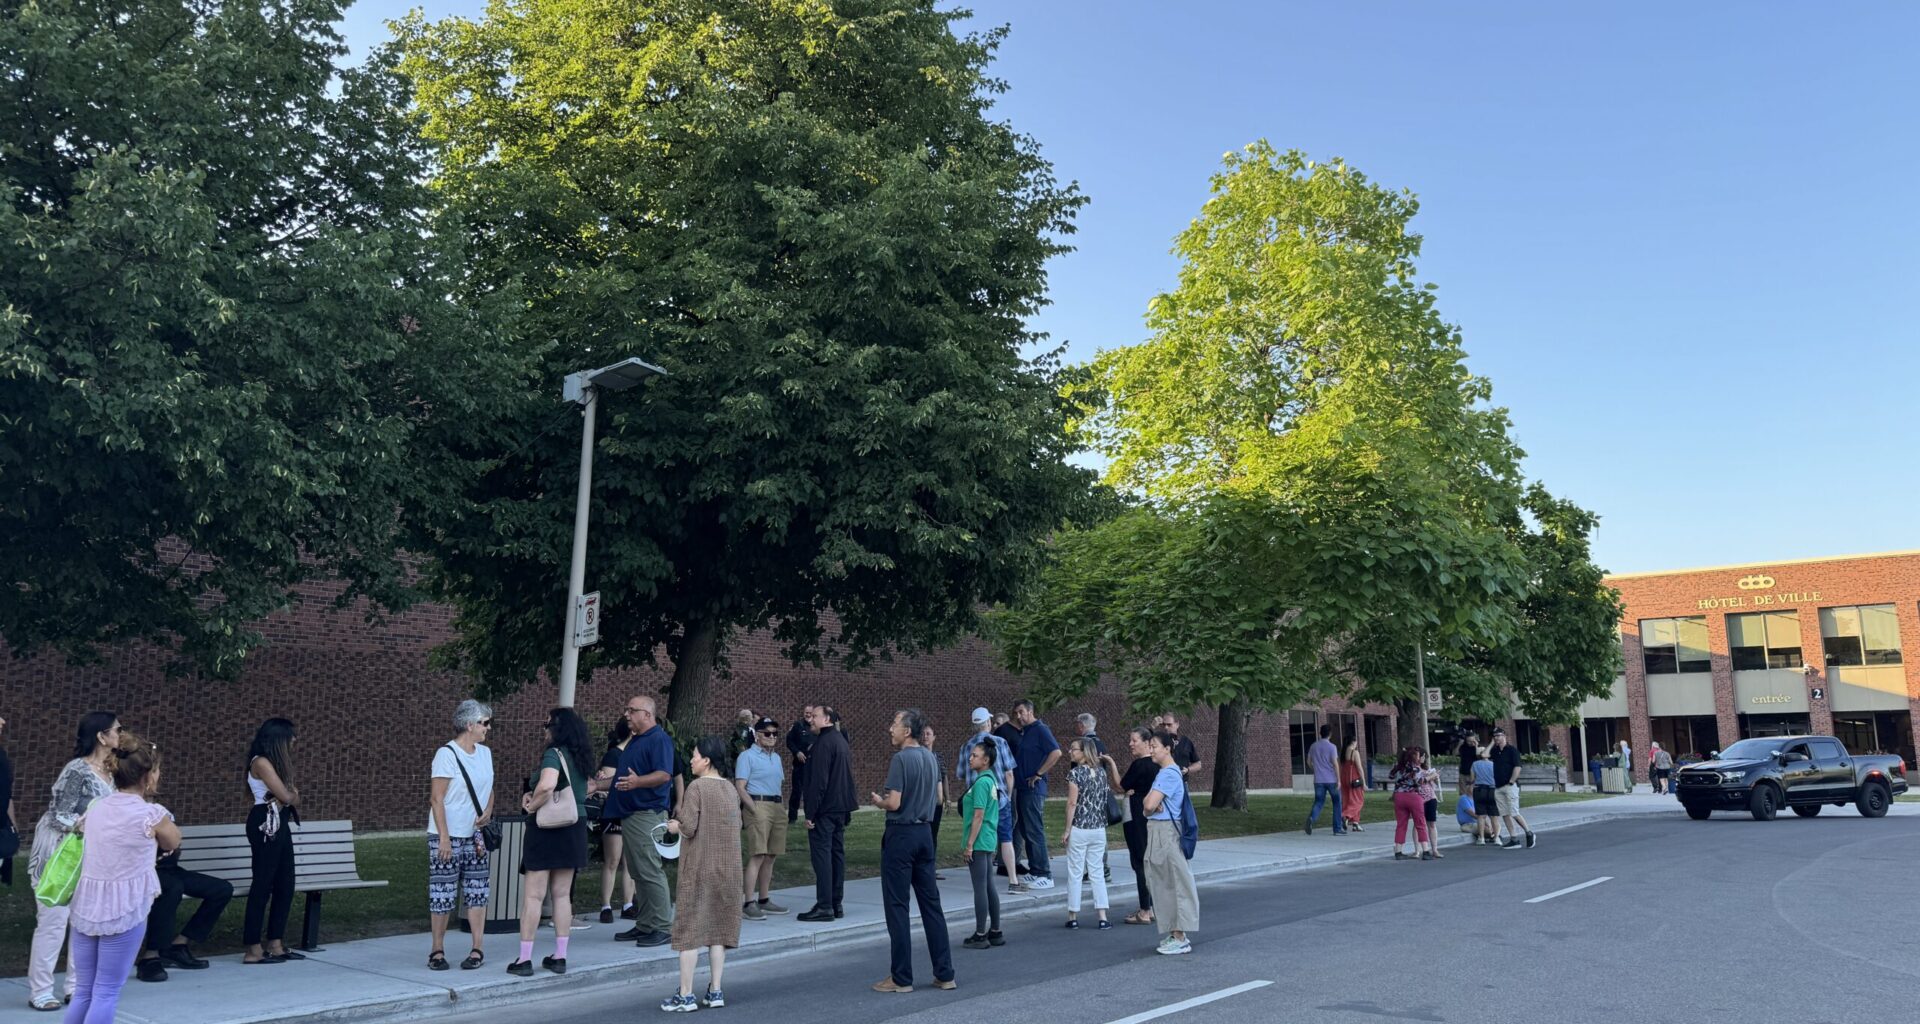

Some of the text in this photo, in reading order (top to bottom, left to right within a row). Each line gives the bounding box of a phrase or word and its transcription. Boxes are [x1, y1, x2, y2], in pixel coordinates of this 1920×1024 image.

[1698, 592, 1823, 609] HÔTEL DE VILLE
[1752, 694, 1791, 703] entrée
[1813, 688, 1822, 699] 2
